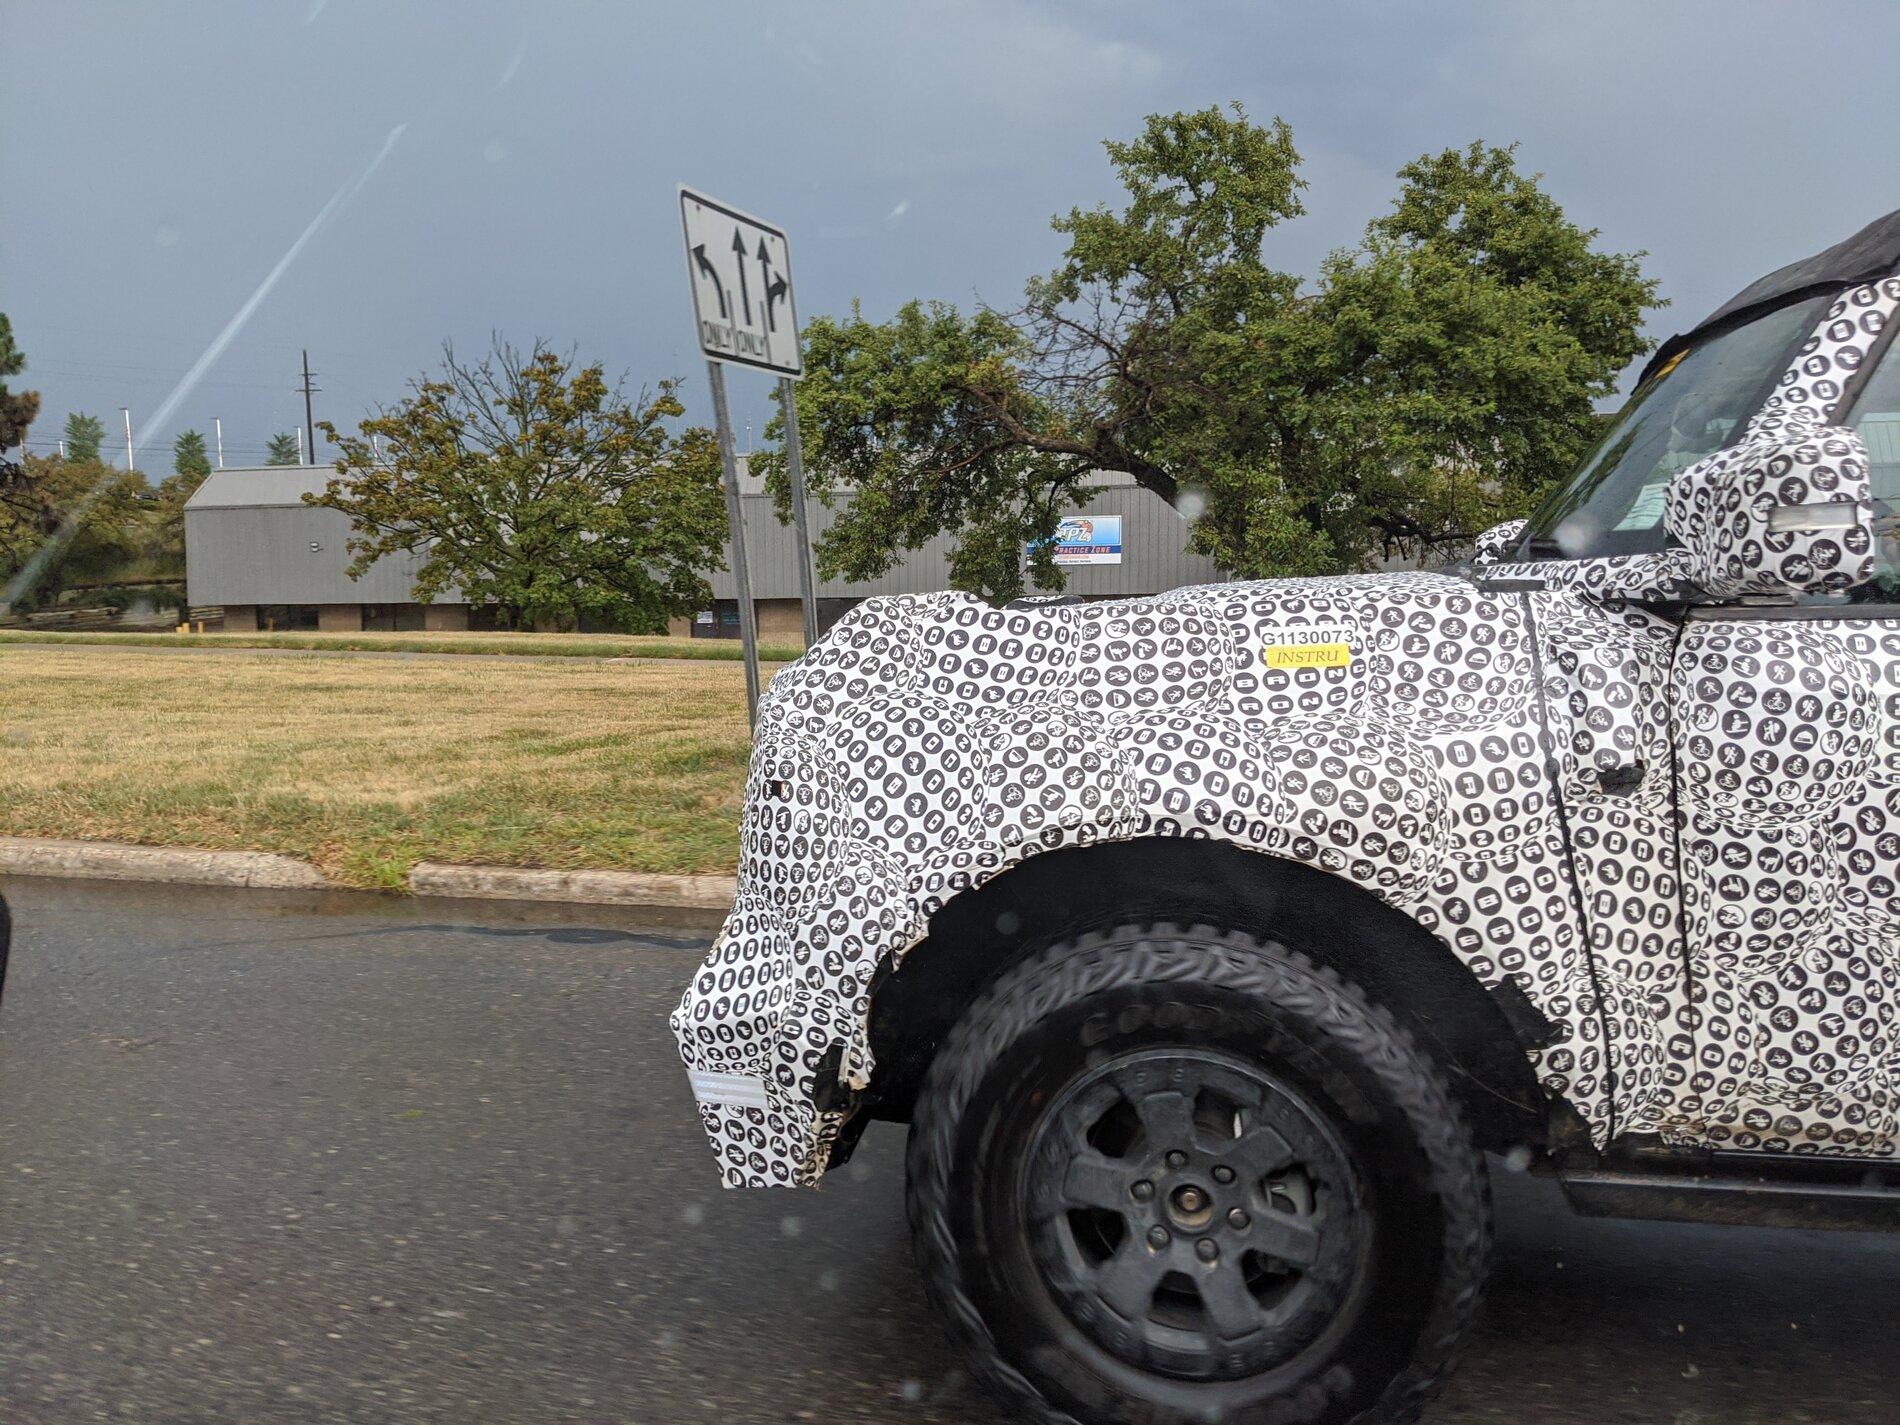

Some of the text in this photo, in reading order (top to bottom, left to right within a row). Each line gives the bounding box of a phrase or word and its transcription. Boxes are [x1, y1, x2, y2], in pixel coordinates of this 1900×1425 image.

[702, 320, 731, 347] ONLY
[736, 330, 766, 355] ONLY
[1060, 527, 1088, 542] TPZ
[1091, 545, 1111, 554] ZONE
[1262, 630, 1354, 645] G1130073
[1277, 650, 1340, 663] INSTRU
